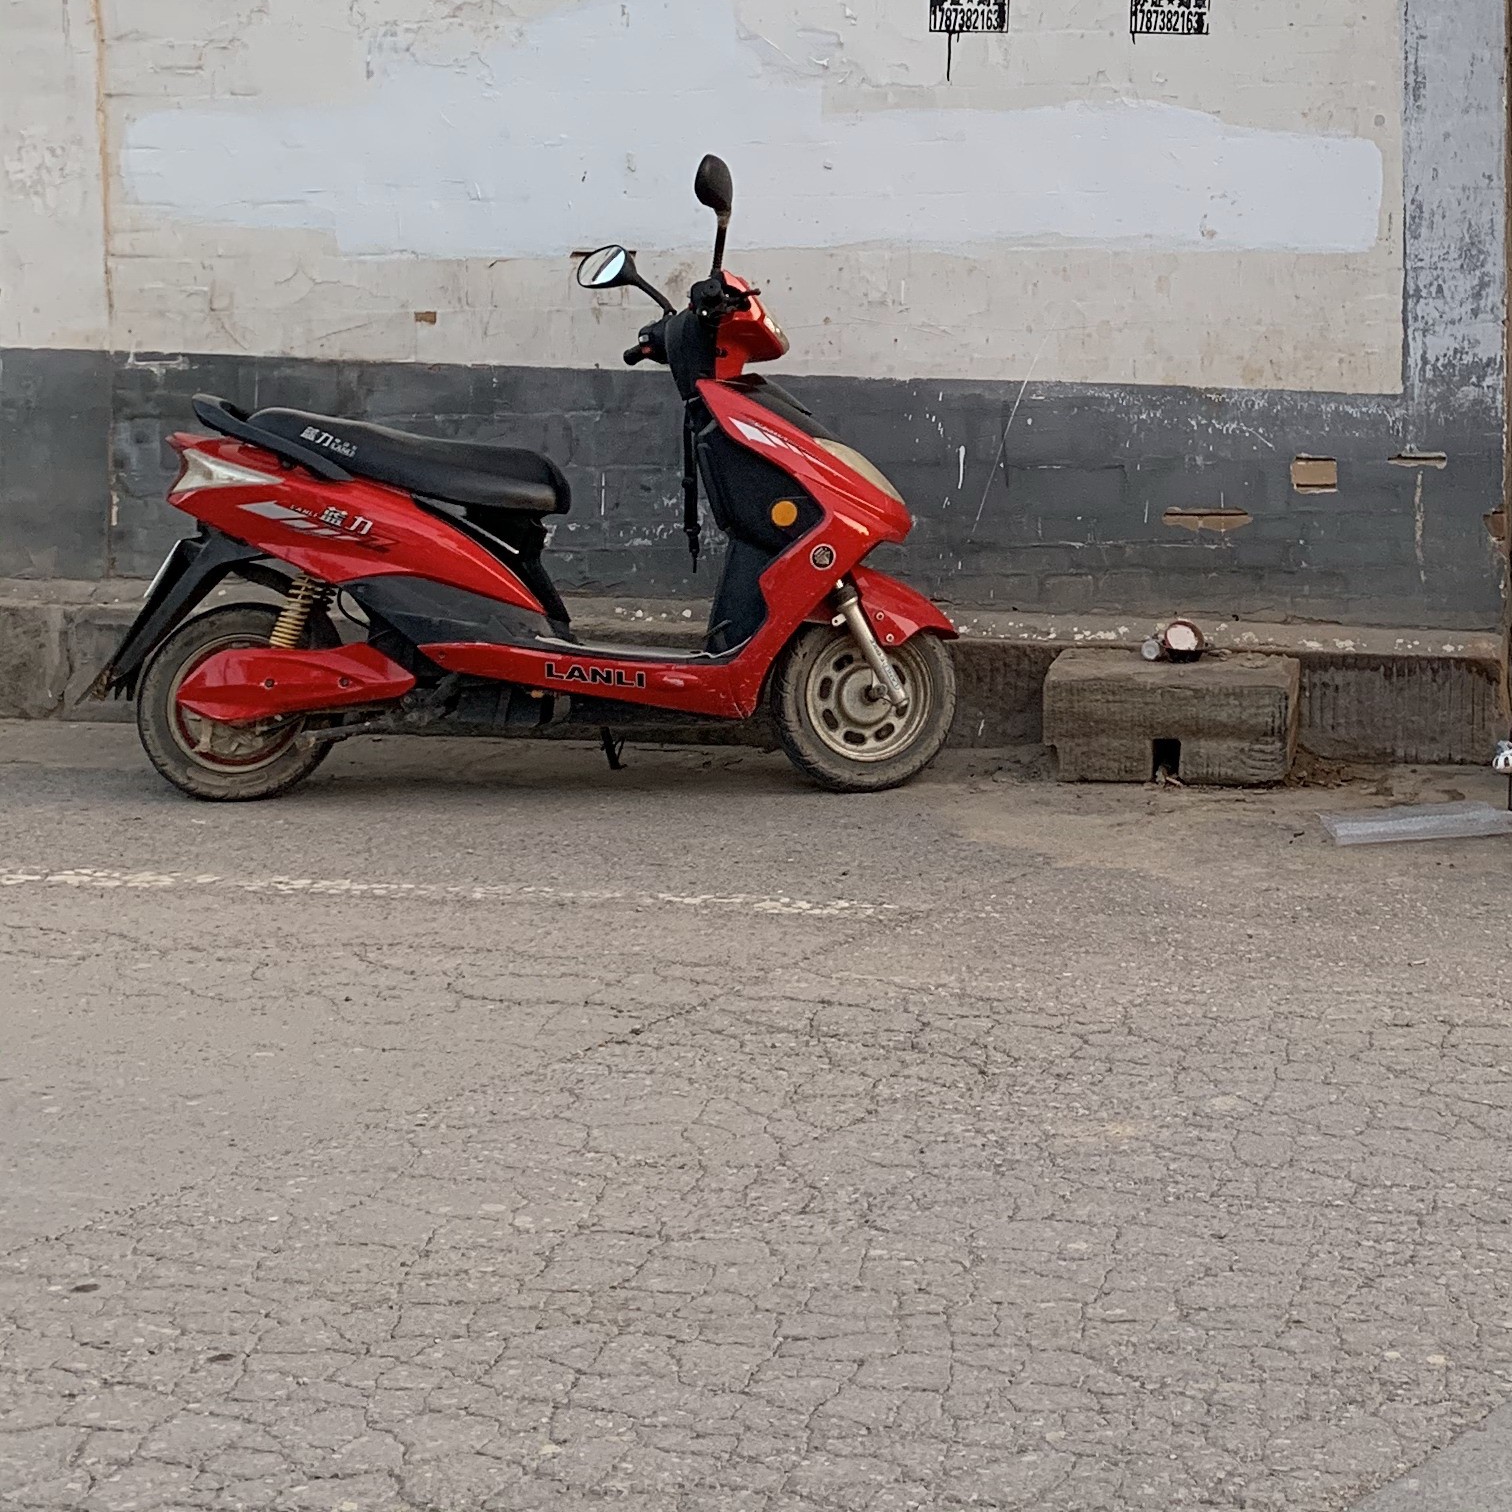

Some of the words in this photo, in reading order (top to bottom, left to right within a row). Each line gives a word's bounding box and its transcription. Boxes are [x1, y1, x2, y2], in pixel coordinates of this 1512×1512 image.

[931, 7, 1006, 31] 1787382163
[318, 506, 374, 536] 蓝力
[544, 661, 647, 690] LANLI
